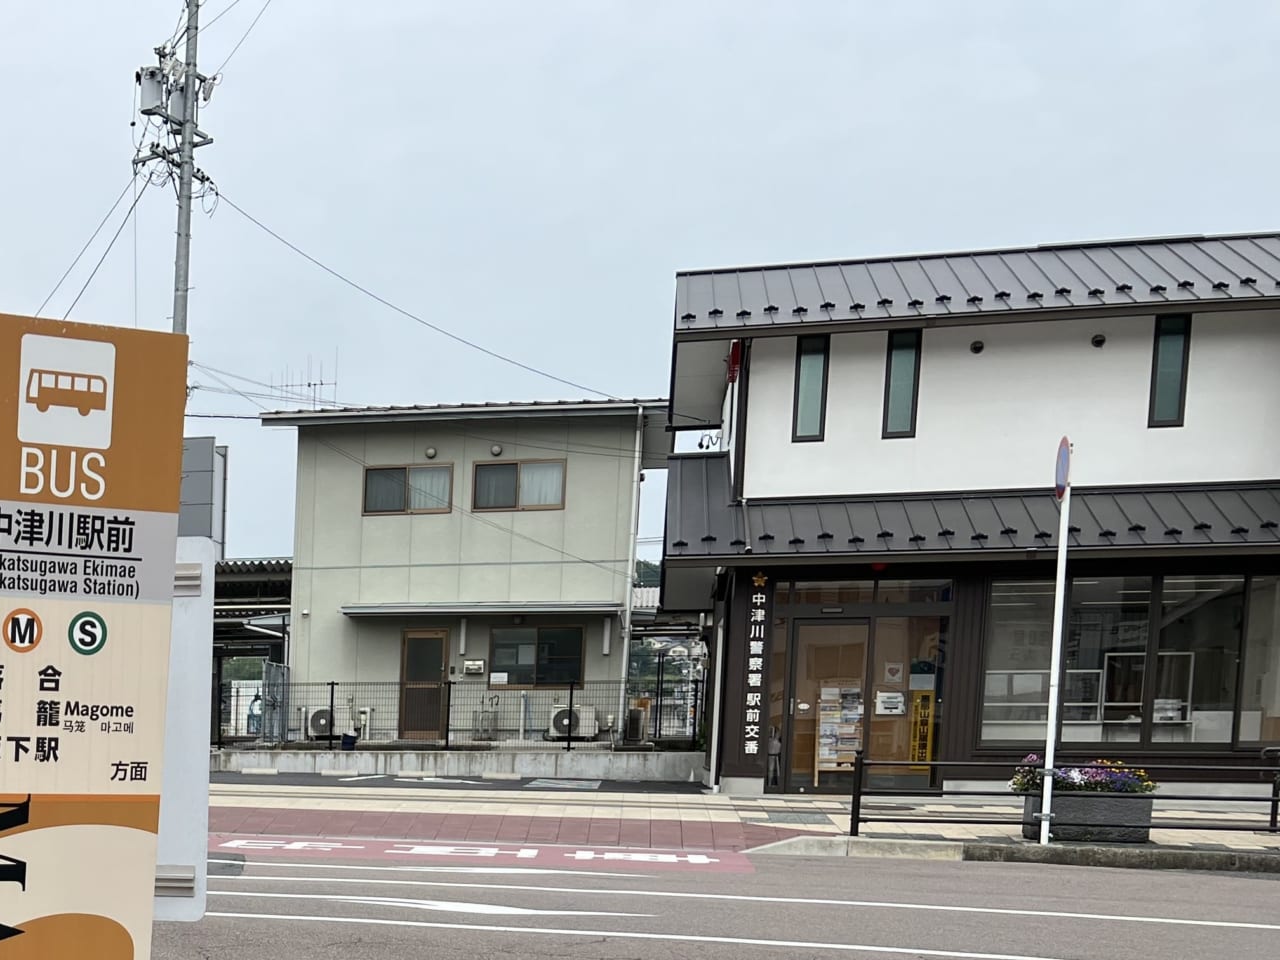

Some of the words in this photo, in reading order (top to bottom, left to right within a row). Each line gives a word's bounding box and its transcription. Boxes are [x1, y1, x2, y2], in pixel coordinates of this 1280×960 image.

[19, 446, 107, 501] BUS
[82, 559, 137, 579] Ekimae
[82, 577, 140, 600] Station)
[10, 617, 35, 644] M
[78, 619, 98, 648] S
[747, 592, 766, 687] 中津川警察署
[64, 700, 134, 721] Magome
[62, 720, 86, 733] 马笼
[100, 721, 134, 734] 마고메
[744, 693, 761, 755] 駅前交番
[110, 760, 149, 782] 方面
